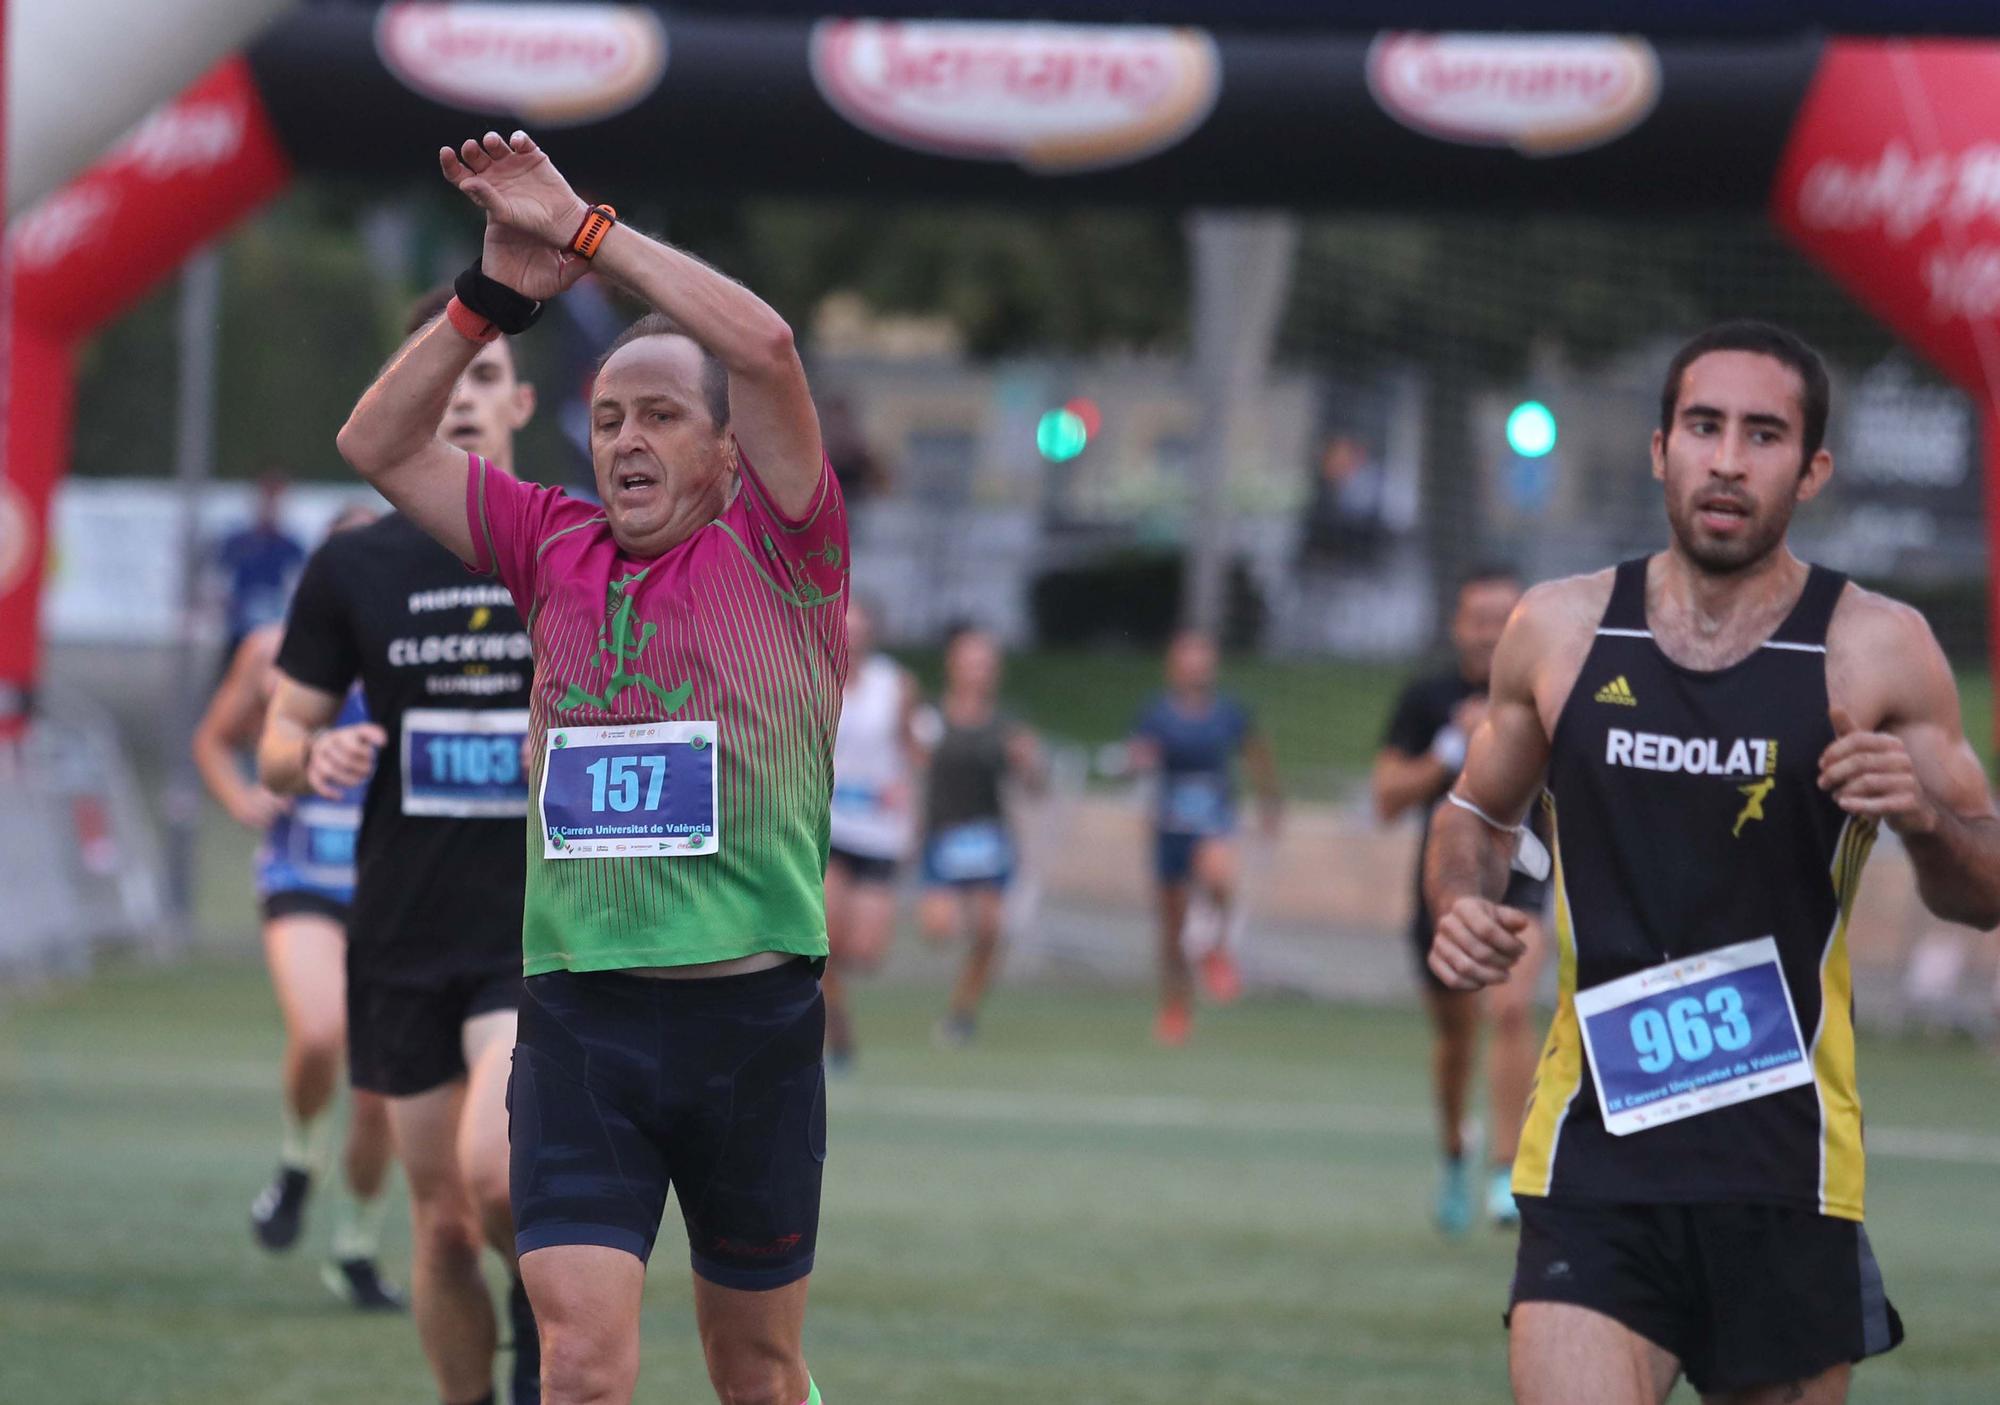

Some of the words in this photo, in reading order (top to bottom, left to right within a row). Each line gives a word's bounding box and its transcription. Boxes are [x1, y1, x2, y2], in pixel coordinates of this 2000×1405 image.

[1594, 691, 1638, 707] adidas
[427, 736, 519, 785] 1103
[1605, 728, 1767, 776] REDOLAT
[585, 755, 667, 813] 157
[561, 826, 593, 836] Carrera
[595, 823, 648, 835] Universitat
[651, 823, 664, 834] de
[667, 823, 712, 834] València
[1628, 985, 1753, 1075] 963
